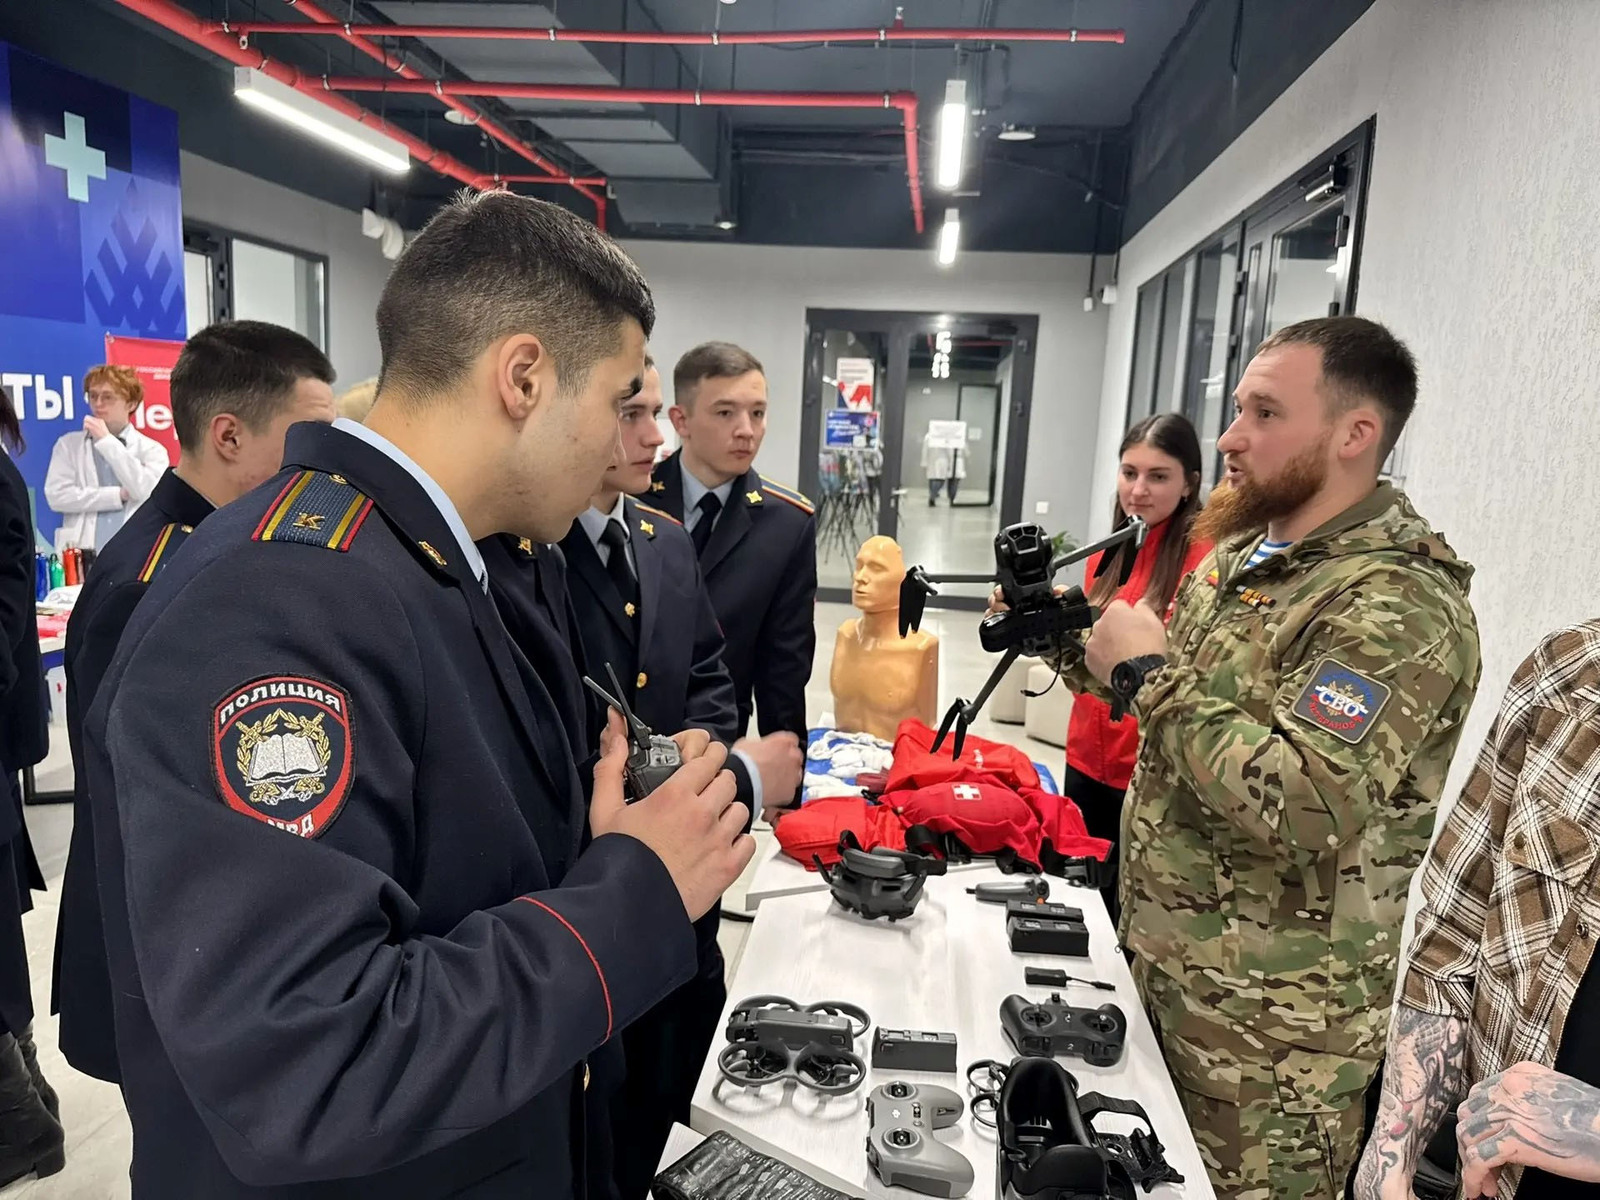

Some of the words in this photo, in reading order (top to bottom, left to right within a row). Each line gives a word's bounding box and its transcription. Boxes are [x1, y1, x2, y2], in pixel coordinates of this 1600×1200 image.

[220, 683, 341, 725] ПОЛИЦИЯ
[1318, 689, 1360, 717] СВО
[267, 813, 315, 838] ВД
